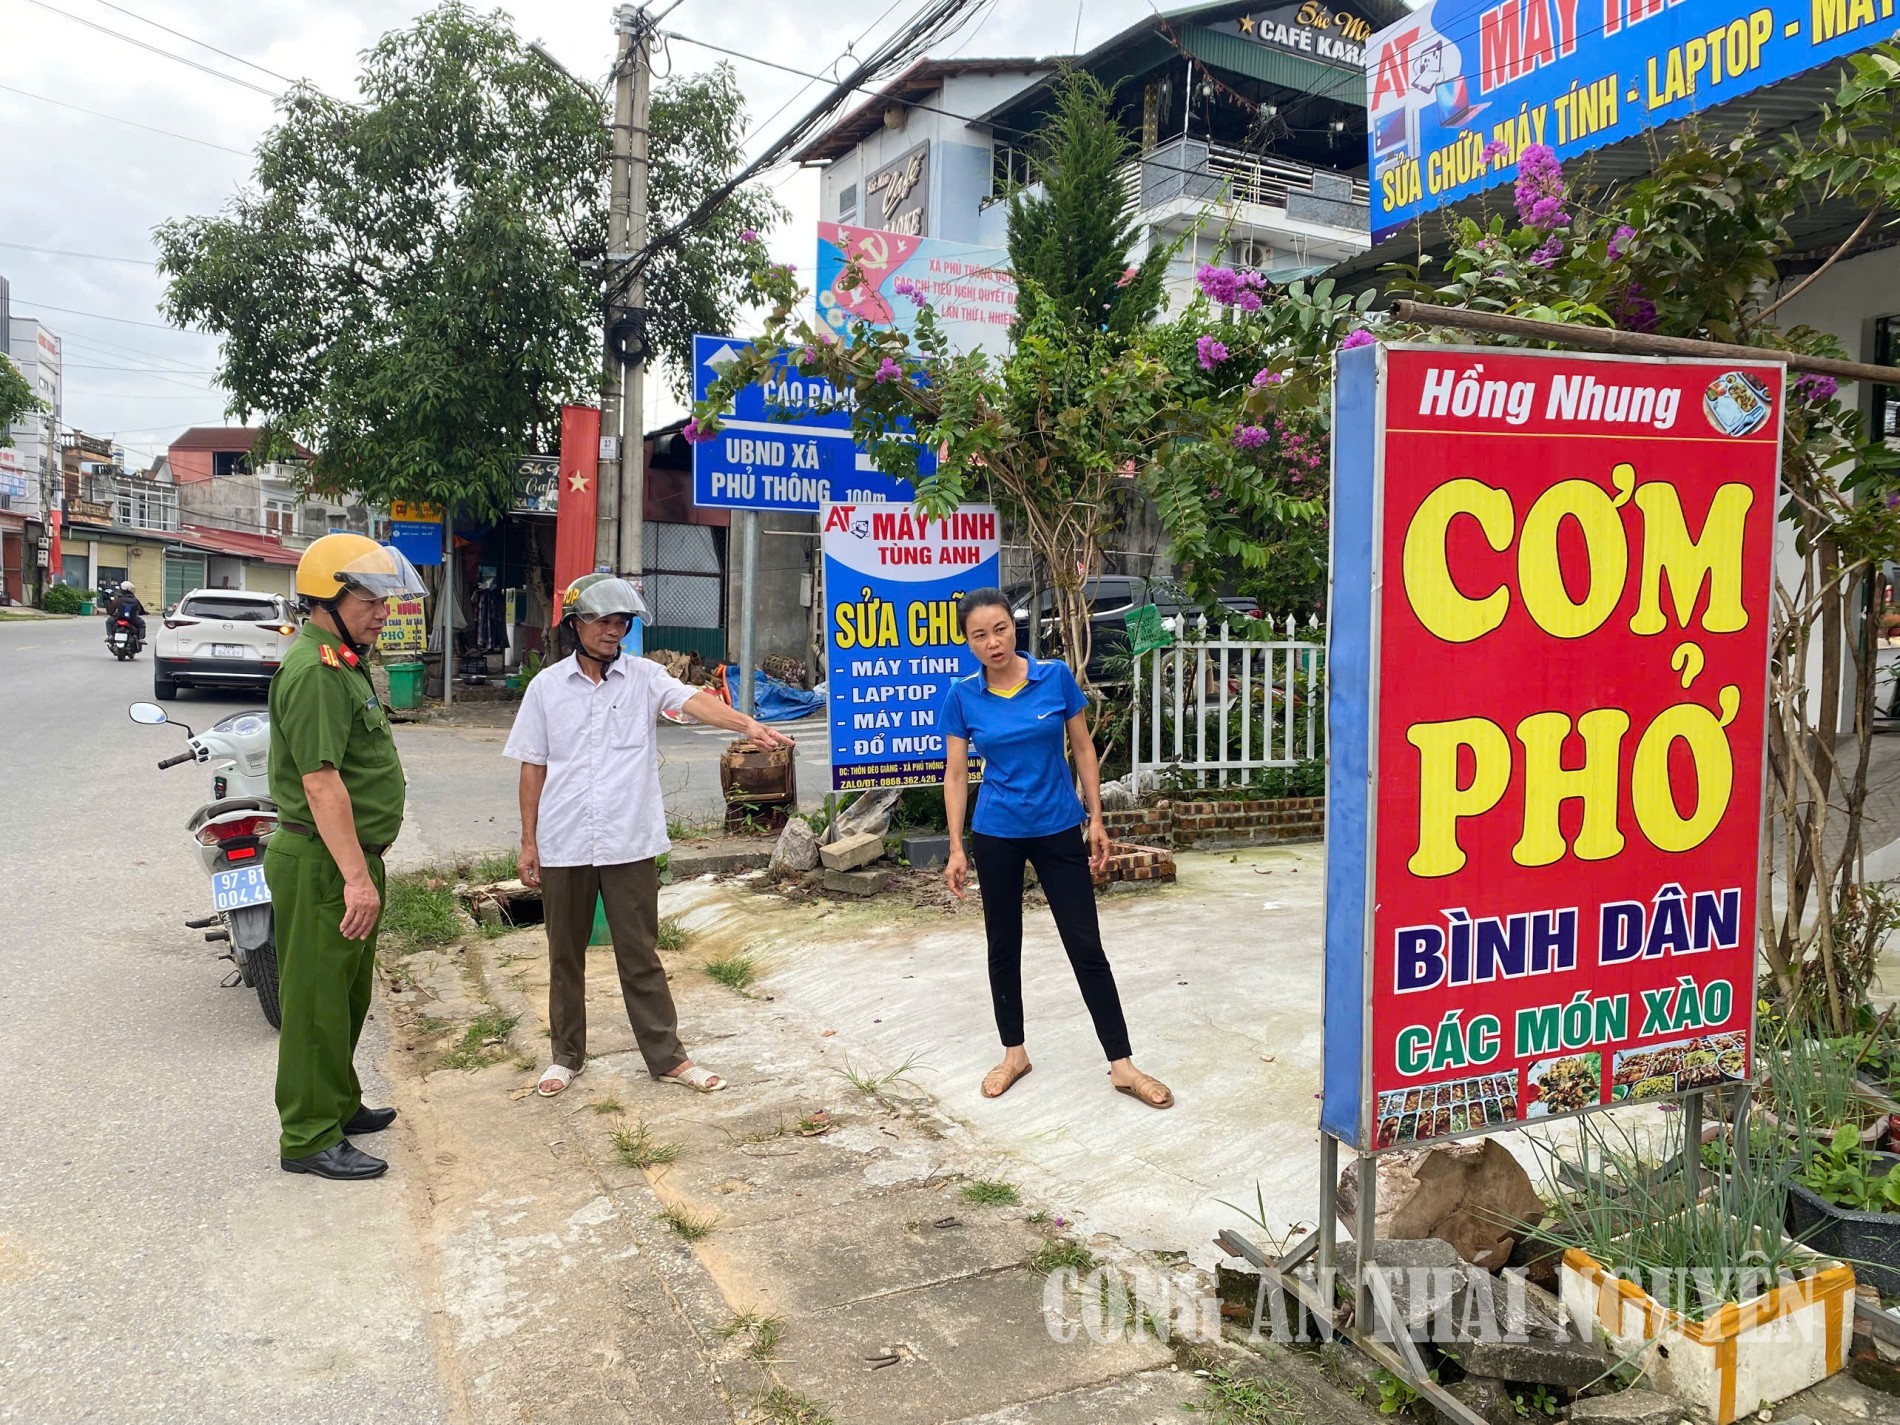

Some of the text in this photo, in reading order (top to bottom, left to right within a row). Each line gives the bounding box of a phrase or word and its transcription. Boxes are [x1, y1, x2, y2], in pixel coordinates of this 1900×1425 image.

[1259, 19, 1312, 51] CAFÉ
[1382, 151, 1423, 212] SỬA
[1428, 129, 1487, 195] CHỮA
[1493, 91, 1548, 172] MÁY
[1555, 73, 1619, 146] TÍNH
[1647, 8, 1774, 110] LAPTOP
[763, 379, 803, 408] CAO
[1419, 364, 1681, 429] Hồng Nhung
[726, 438, 820, 470] UBND XÃ
[711, 466, 887, 503] PHỦ THÔNG 100m
[825, 506, 856, 532] AT
[872, 507, 929, 541] MÁY
[878, 543, 980, 565] TÙNG ANH
[1403, 463, 1754, 643] CƠM
[381, 627, 404, 640] PHỞ
[834, 586, 966, 649] SỬA CHỮ
[852, 657, 902, 677] MÁY
[909, 655, 959, 675] TÍNH
[852, 684, 937, 703] LAPTOP
[854, 709, 903, 730] MÁY
[911, 709, 934, 727] IN
[854, 733, 885, 757] ĐỔ
[892, 734, 942, 756] MỰC
[1406, 642, 1741, 877] PHỞ
[839, 767, 849, 776] ĐC:
[850, 765, 866, 775] THÔN
[925, 760, 944, 770] THÔNG
[1394, 883, 1741, 994] BÌNH DÂN
[1396, 975, 1733, 1076] CÁC MÓN XÀO
